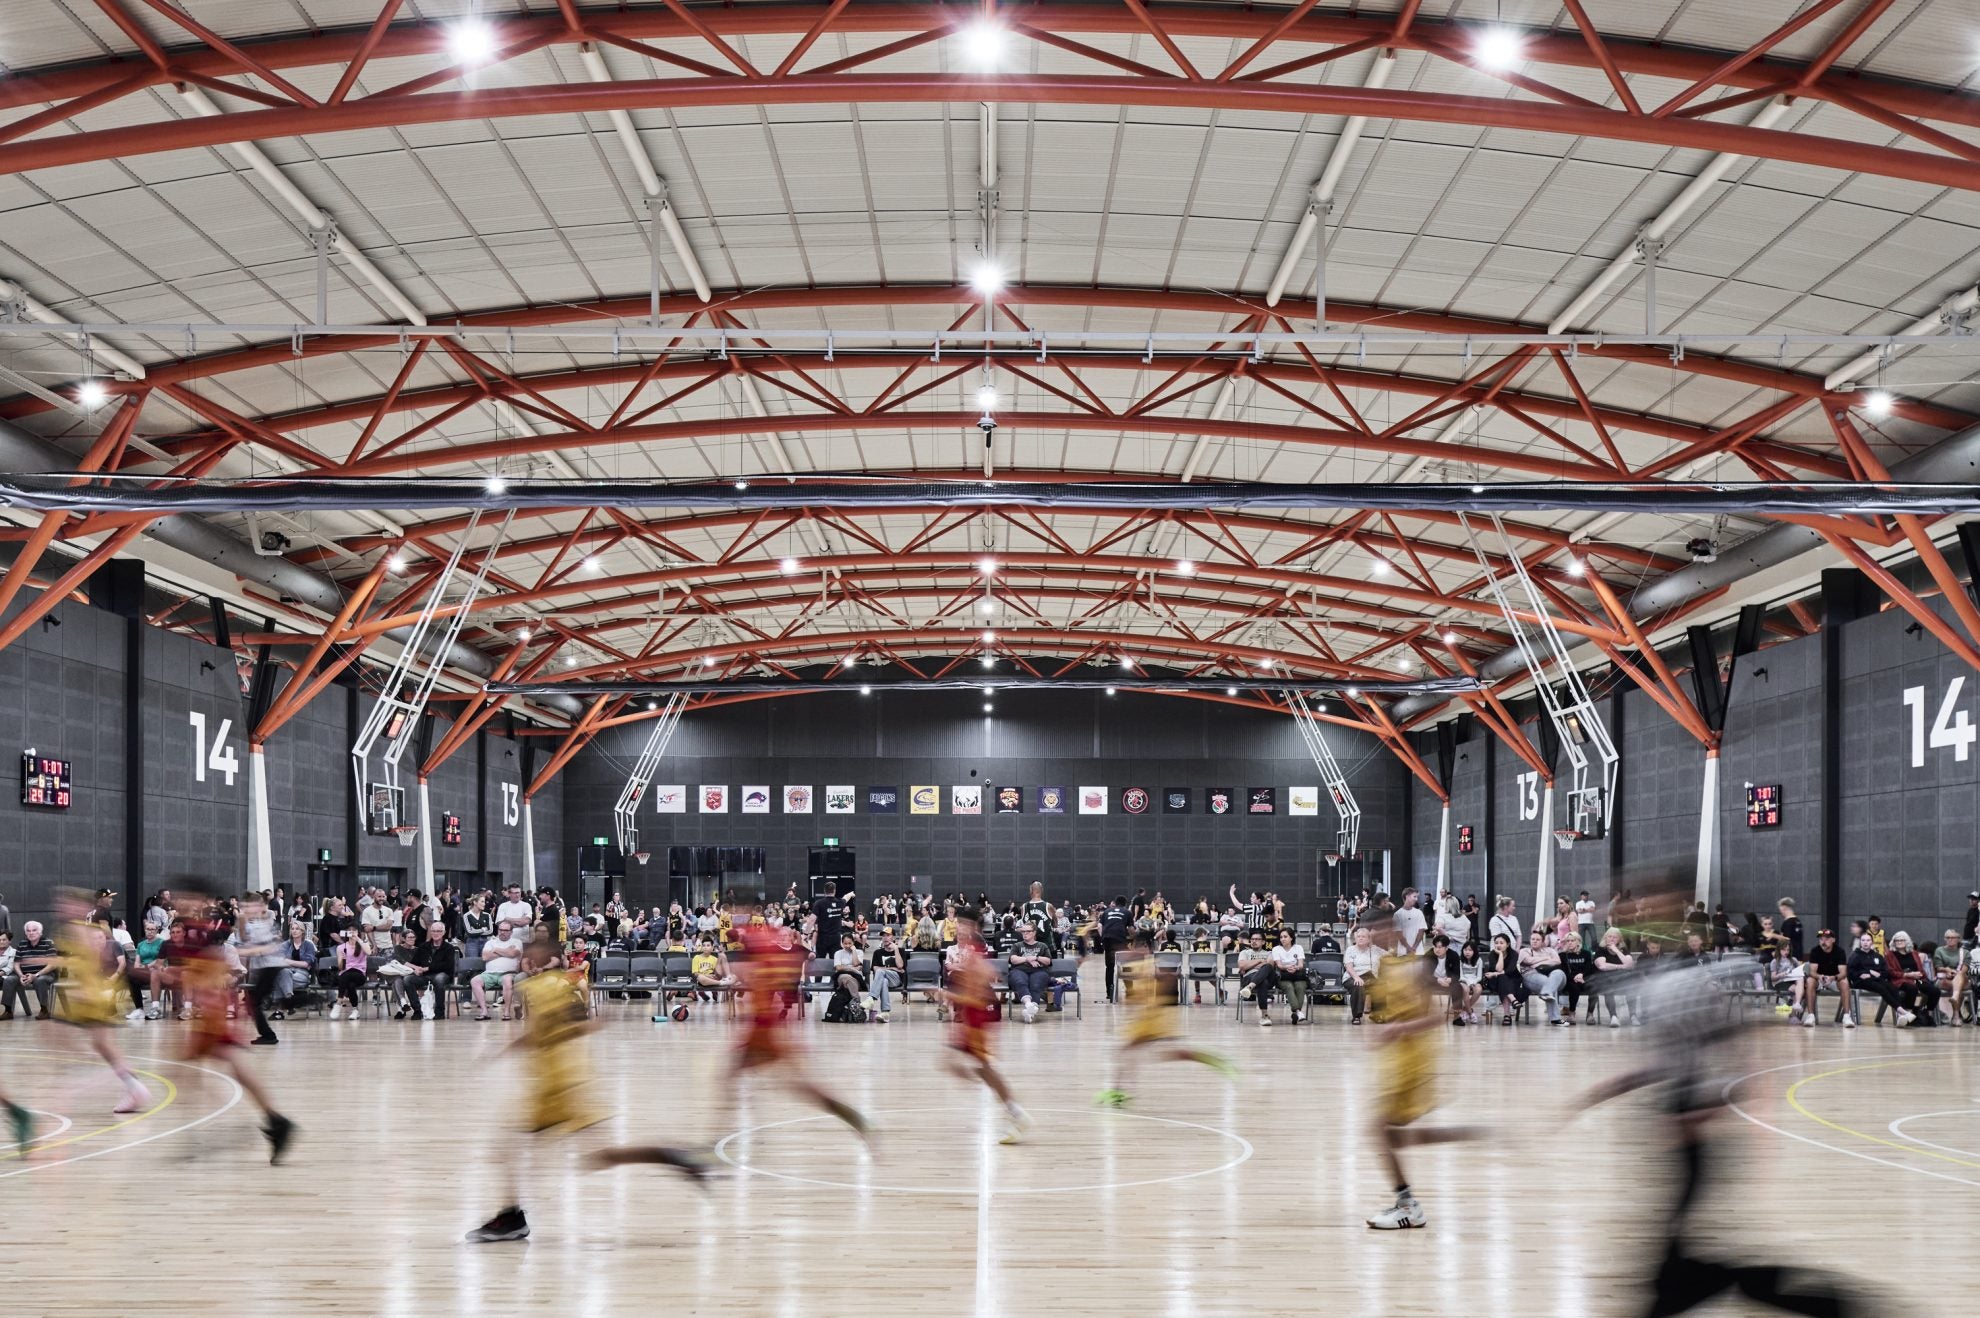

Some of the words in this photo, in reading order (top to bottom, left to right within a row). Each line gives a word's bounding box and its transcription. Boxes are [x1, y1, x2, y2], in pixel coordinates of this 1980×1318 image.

[1904, 676, 1977, 768] 14
[189, 711, 239, 786] 14
[42, 759, 63, 775] 7:07
[31, 788, 44, 803] 29
[57, 791, 69, 805] 20
[827, 794, 855, 804] LAKERS
[1516, 770, 1539, 821] 13
[501, 782, 519, 827] 13
[720, 919, 731, 928] 36
